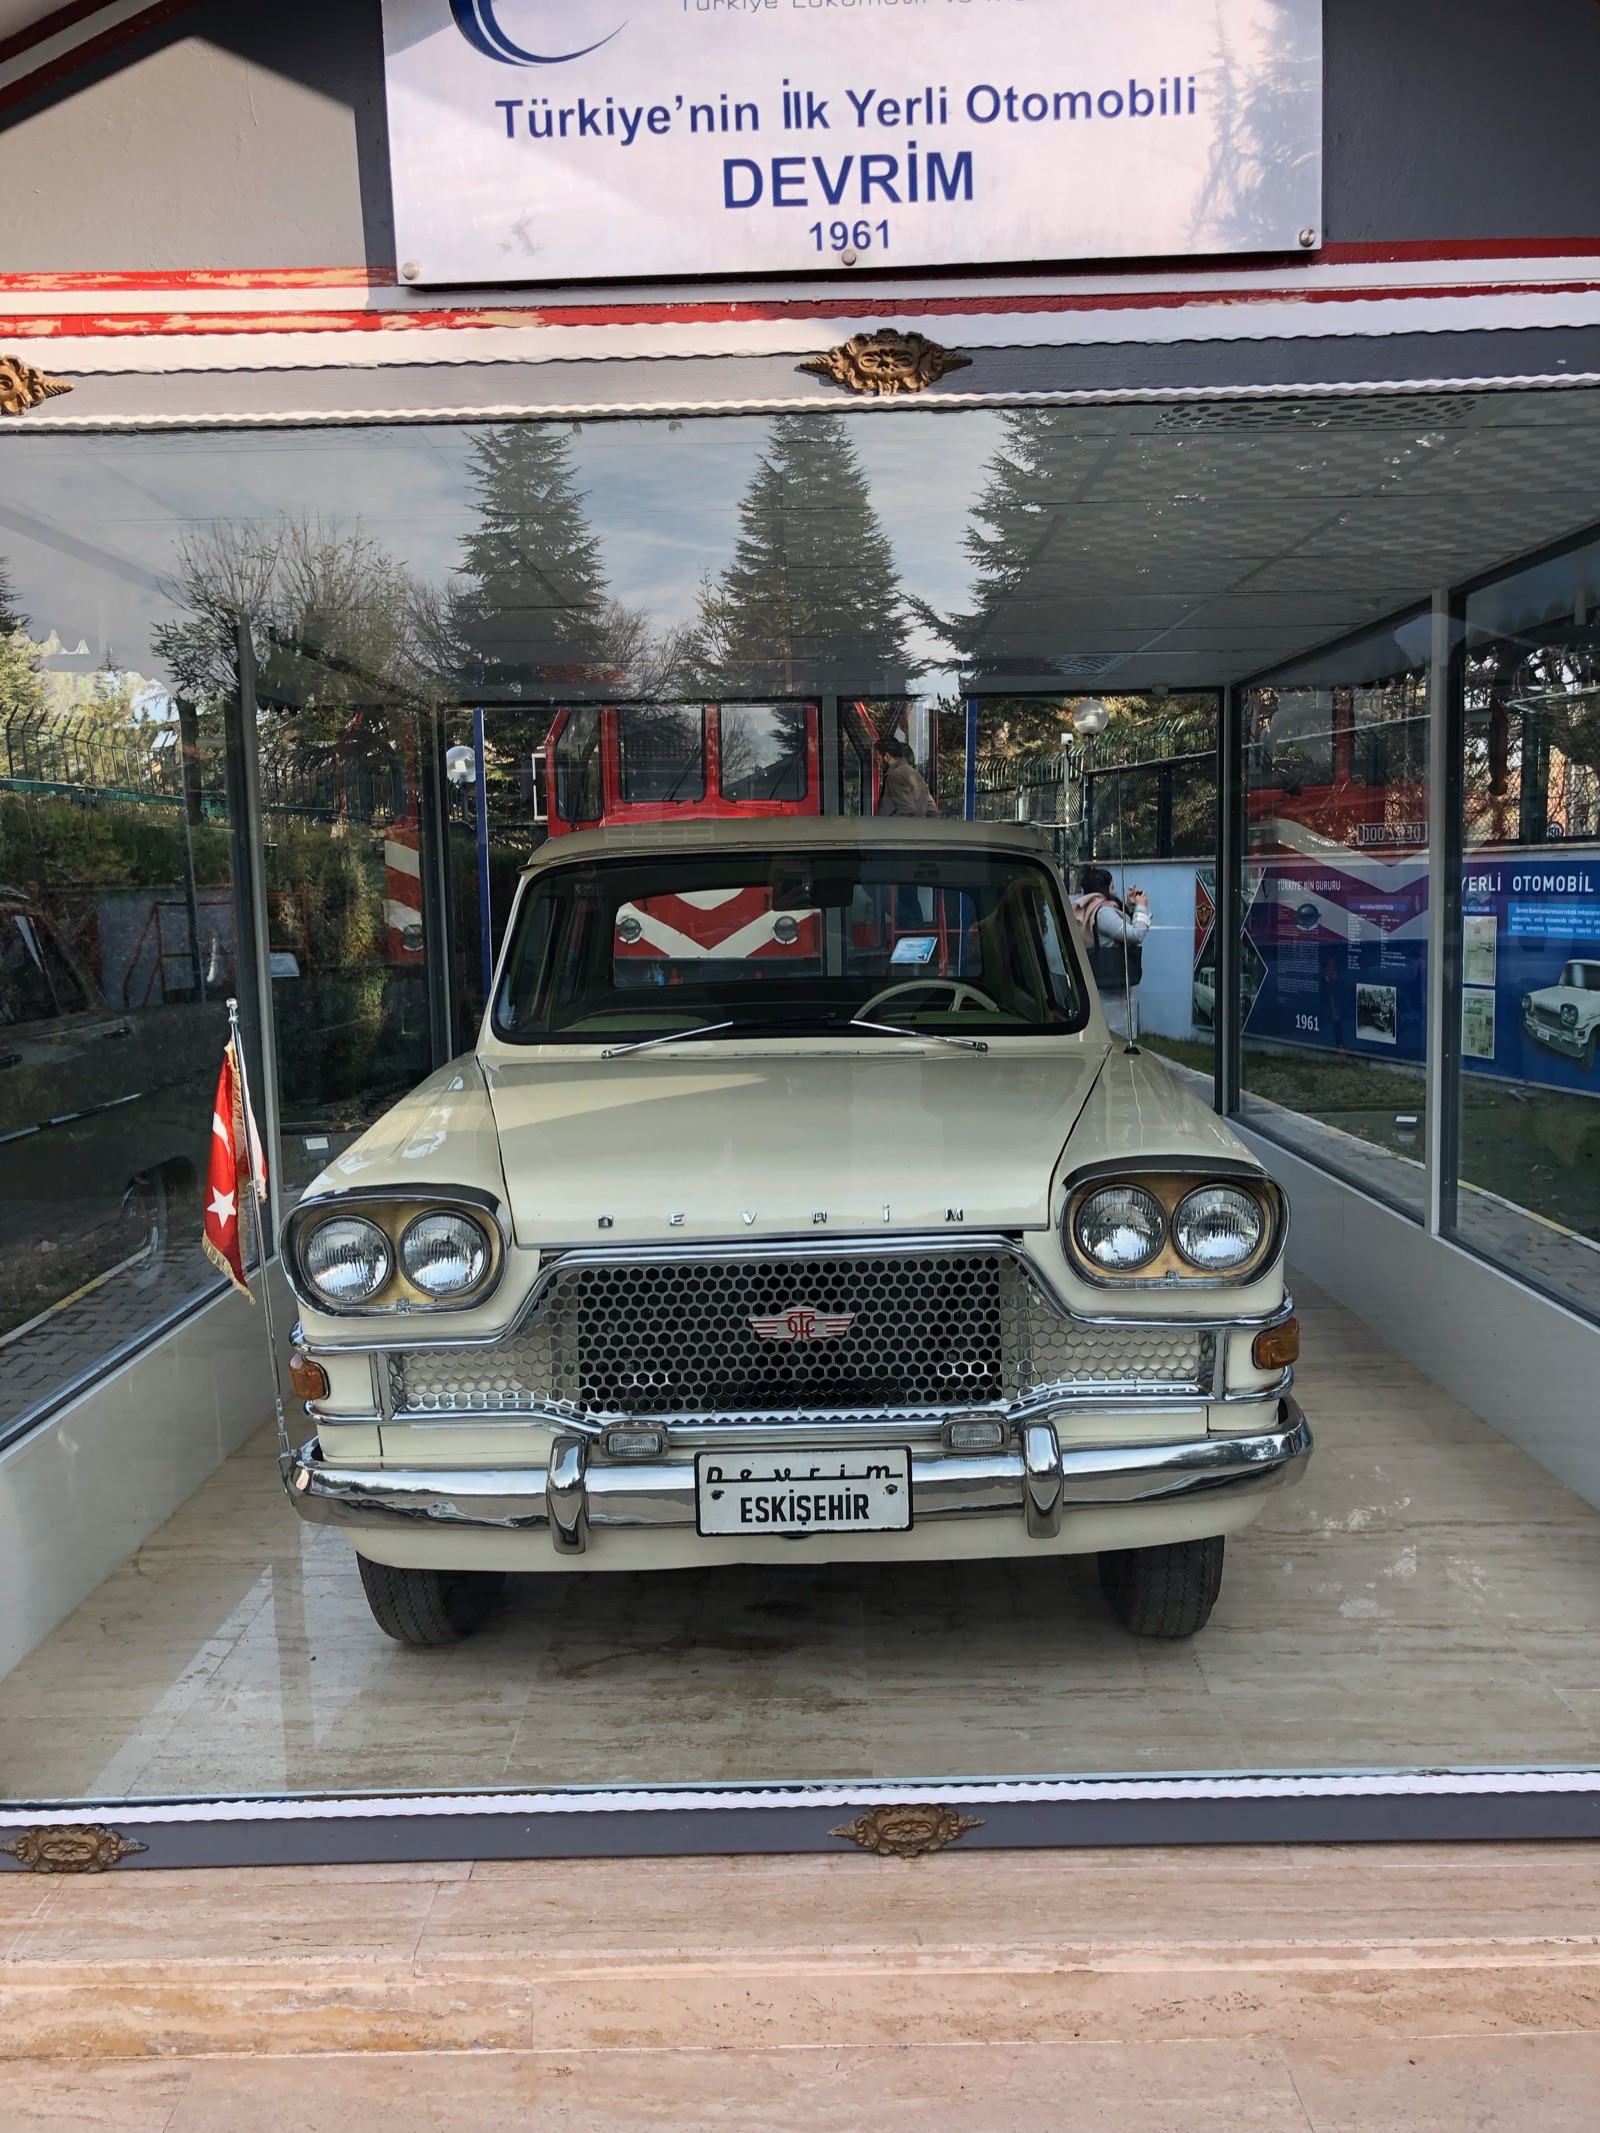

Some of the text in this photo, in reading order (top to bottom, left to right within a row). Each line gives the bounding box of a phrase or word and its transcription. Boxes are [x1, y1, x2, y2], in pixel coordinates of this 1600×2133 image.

[783, 78, 830, 130] İlk
[845, 86, 947, 129] Yerli
[966, 76, 1195, 123] Otomobili
[723, 140, 973, 209] DEVRİM
[809, 219, 889, 252] 1961
[1315, 880, 1341, 891] GURURU
[1512, 872, 1594, 893] OTOMOBİL
[1295, 1013, 1319, 1031] 1961
[705, 1464, 904, 1485] Devrim
[740, 1488, 870, 1527] ESKİŞEHİR
